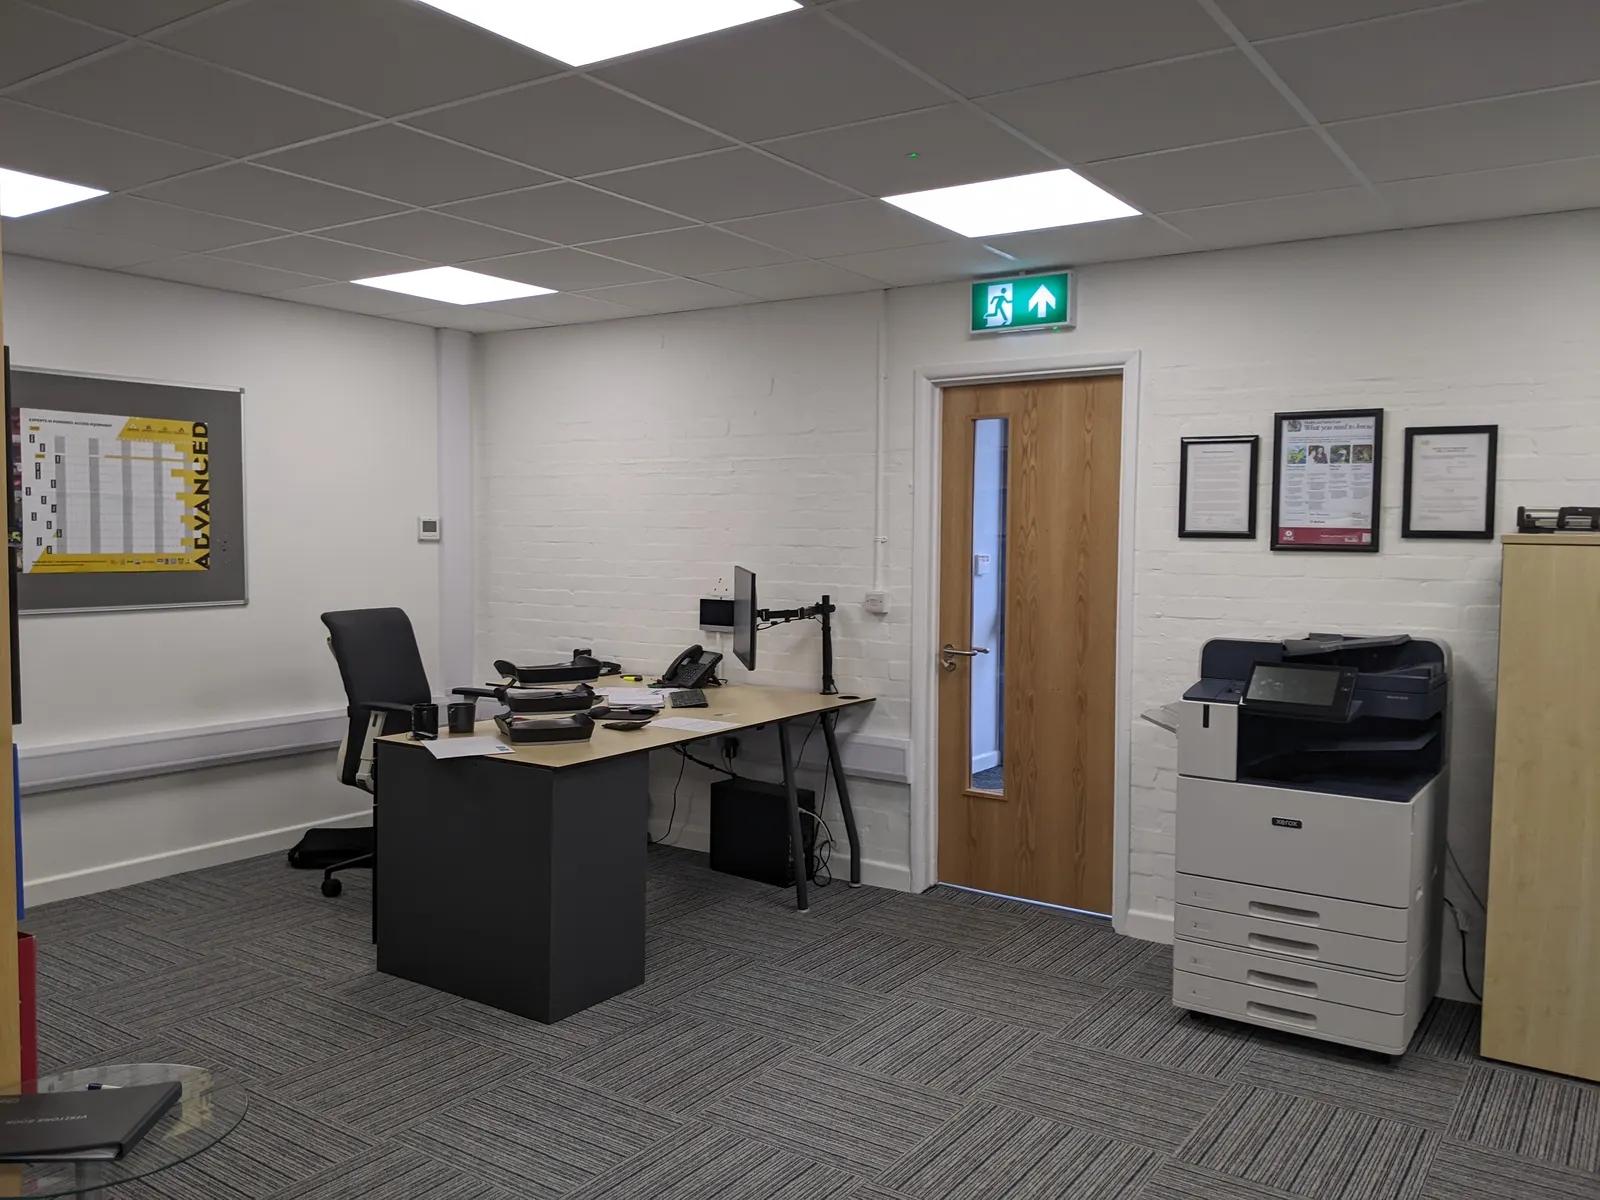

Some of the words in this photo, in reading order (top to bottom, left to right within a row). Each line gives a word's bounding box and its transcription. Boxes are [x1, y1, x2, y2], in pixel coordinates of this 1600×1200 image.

[193, 422, 210, 569] ADVANCED
[1276, 819, 1298, 827] xerox
[37, 1114, 87, 1123] VISITORS
